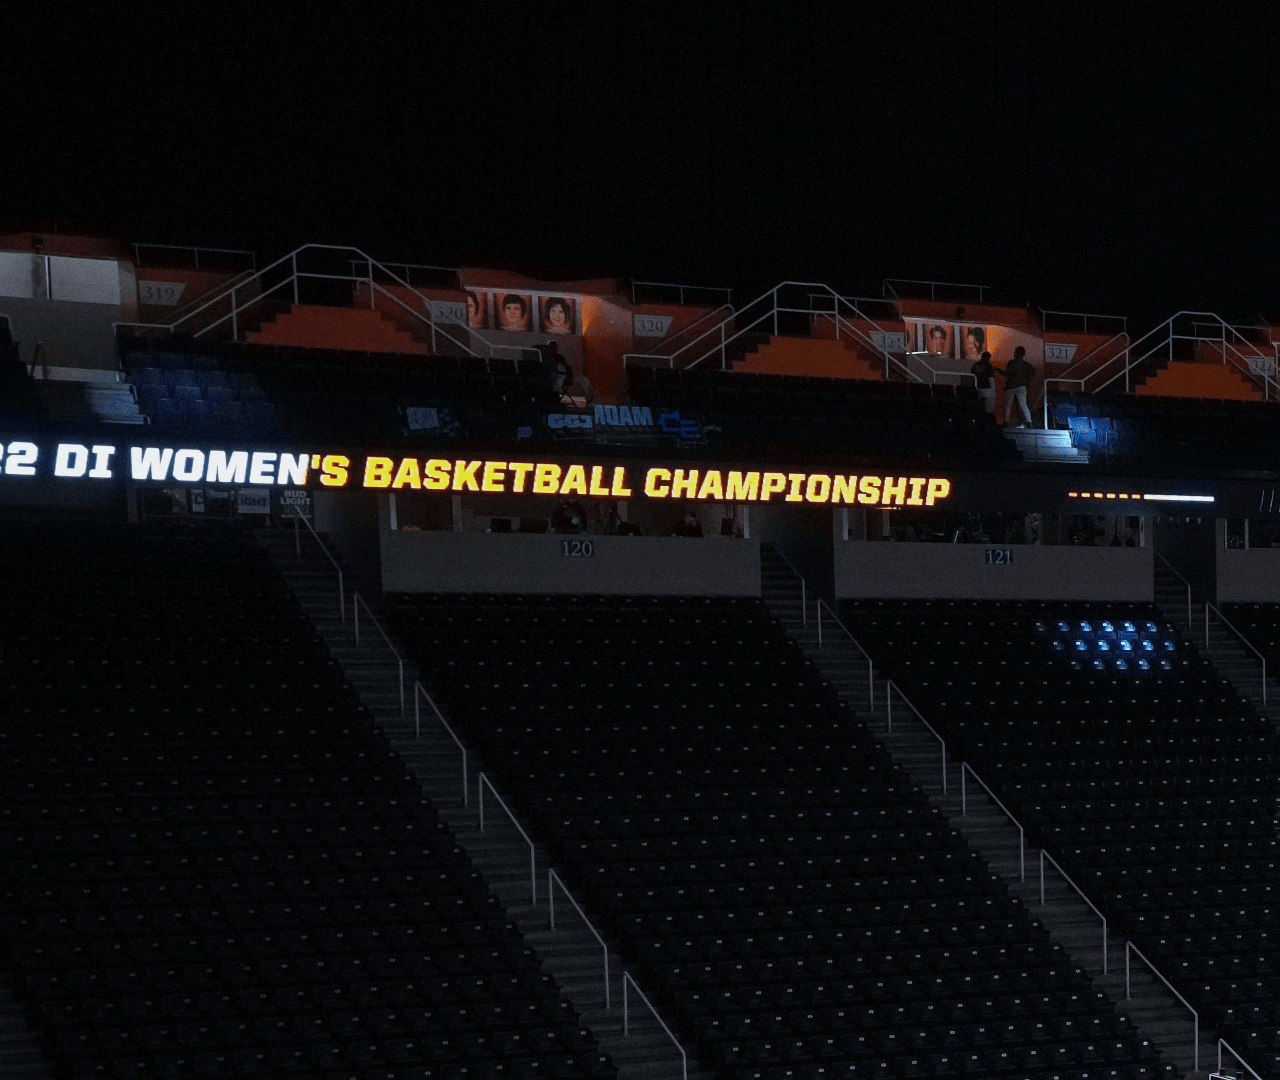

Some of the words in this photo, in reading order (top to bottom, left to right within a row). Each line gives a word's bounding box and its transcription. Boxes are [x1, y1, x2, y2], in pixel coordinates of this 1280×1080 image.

[54, 443, 116, 478] DI
[130, 446, 350, 487] WOMEN'S
[362, 456, 632, 497] BASKETBALL
[644, 468, 950, 506] CHAMPIONSHIP
[562, 541, 594, 557] 120
[986, 550, 1013, 564] 121
